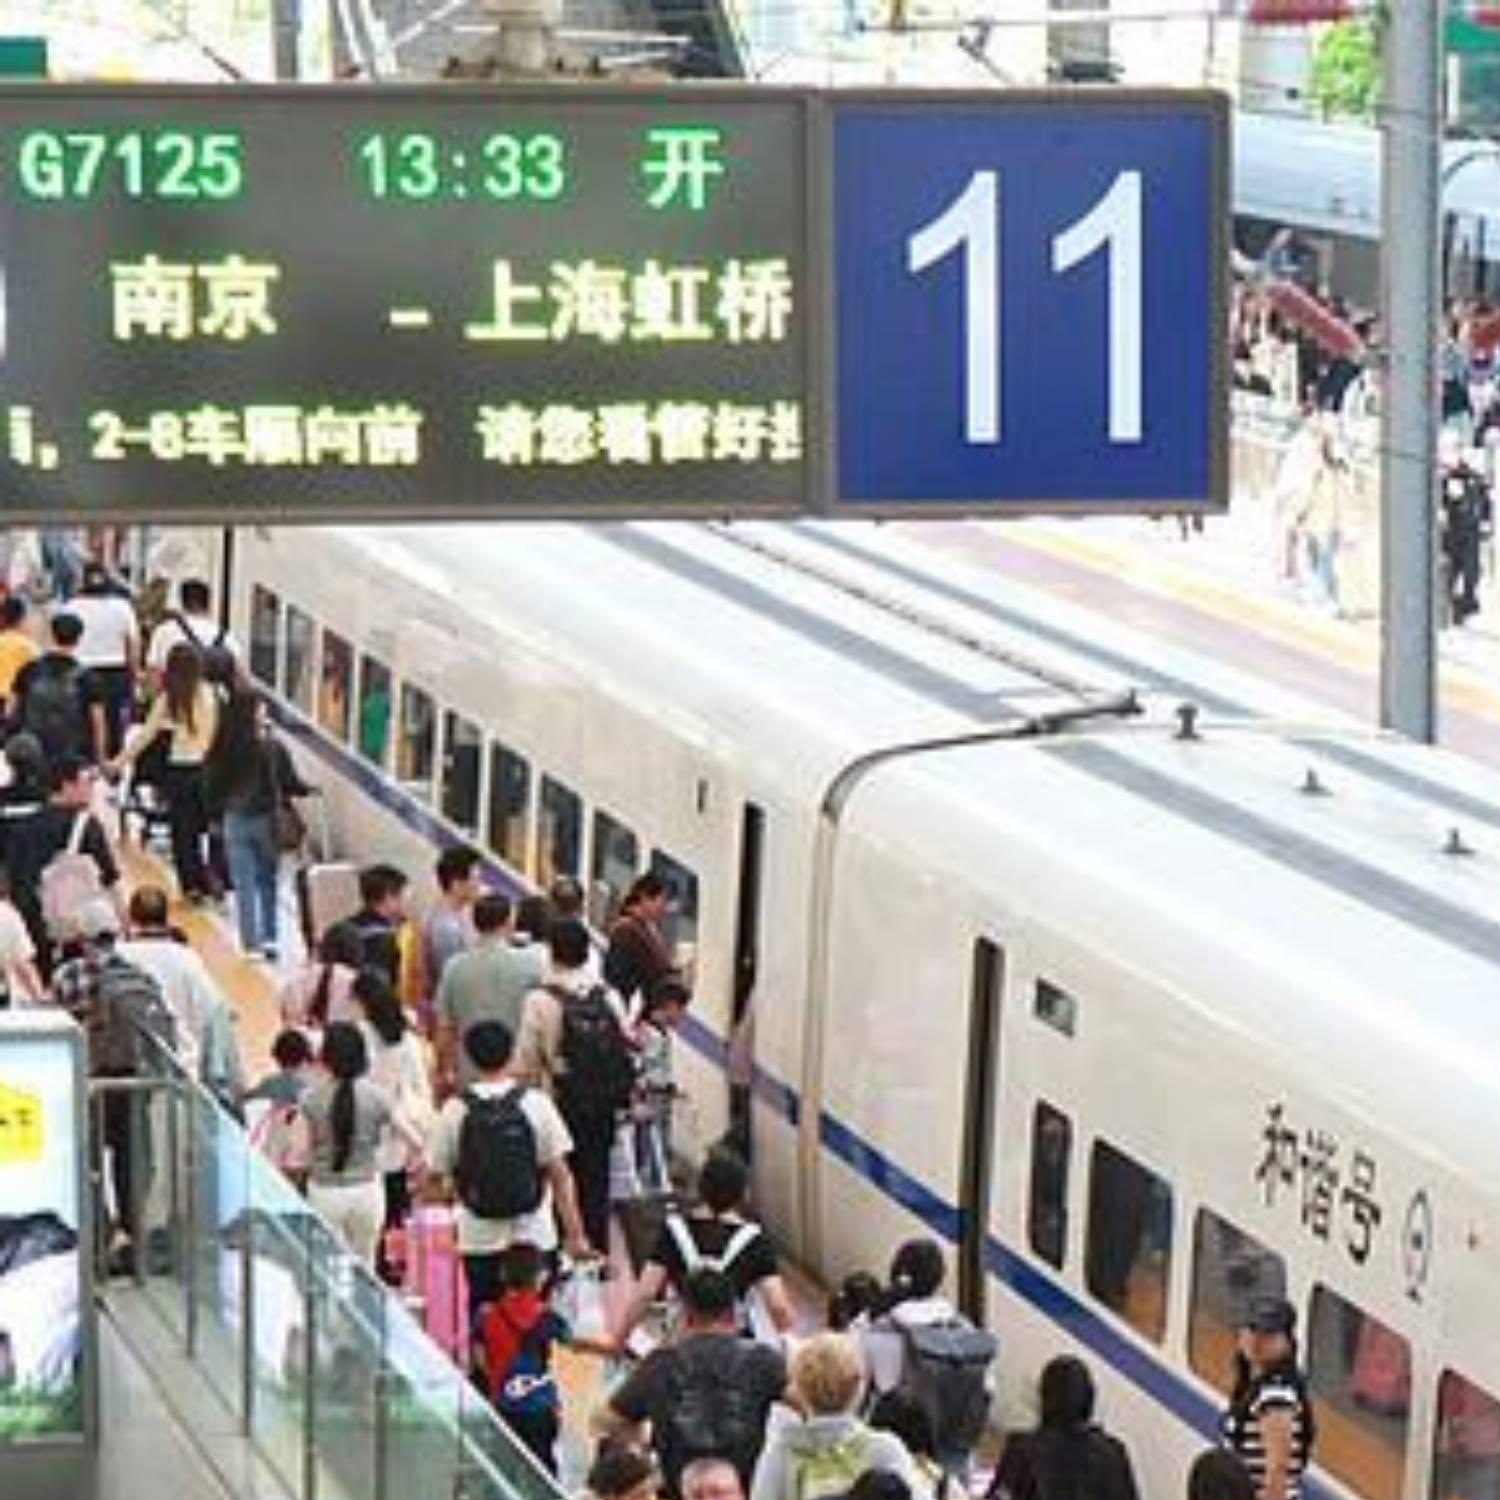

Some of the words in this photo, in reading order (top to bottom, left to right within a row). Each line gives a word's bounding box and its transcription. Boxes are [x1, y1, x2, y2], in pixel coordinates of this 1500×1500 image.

[18, 131, 243, 198] G7125
[359, 133, 568, 199] 13:33
[643, 128, 725, 210] 开
[110, 253, 280, 341] 南京
[464, 257, 795, 345] 上海虹桥
[907, 169, 1143, 444] 11
[1255, 1101, 1382, 1267] 和谐号
